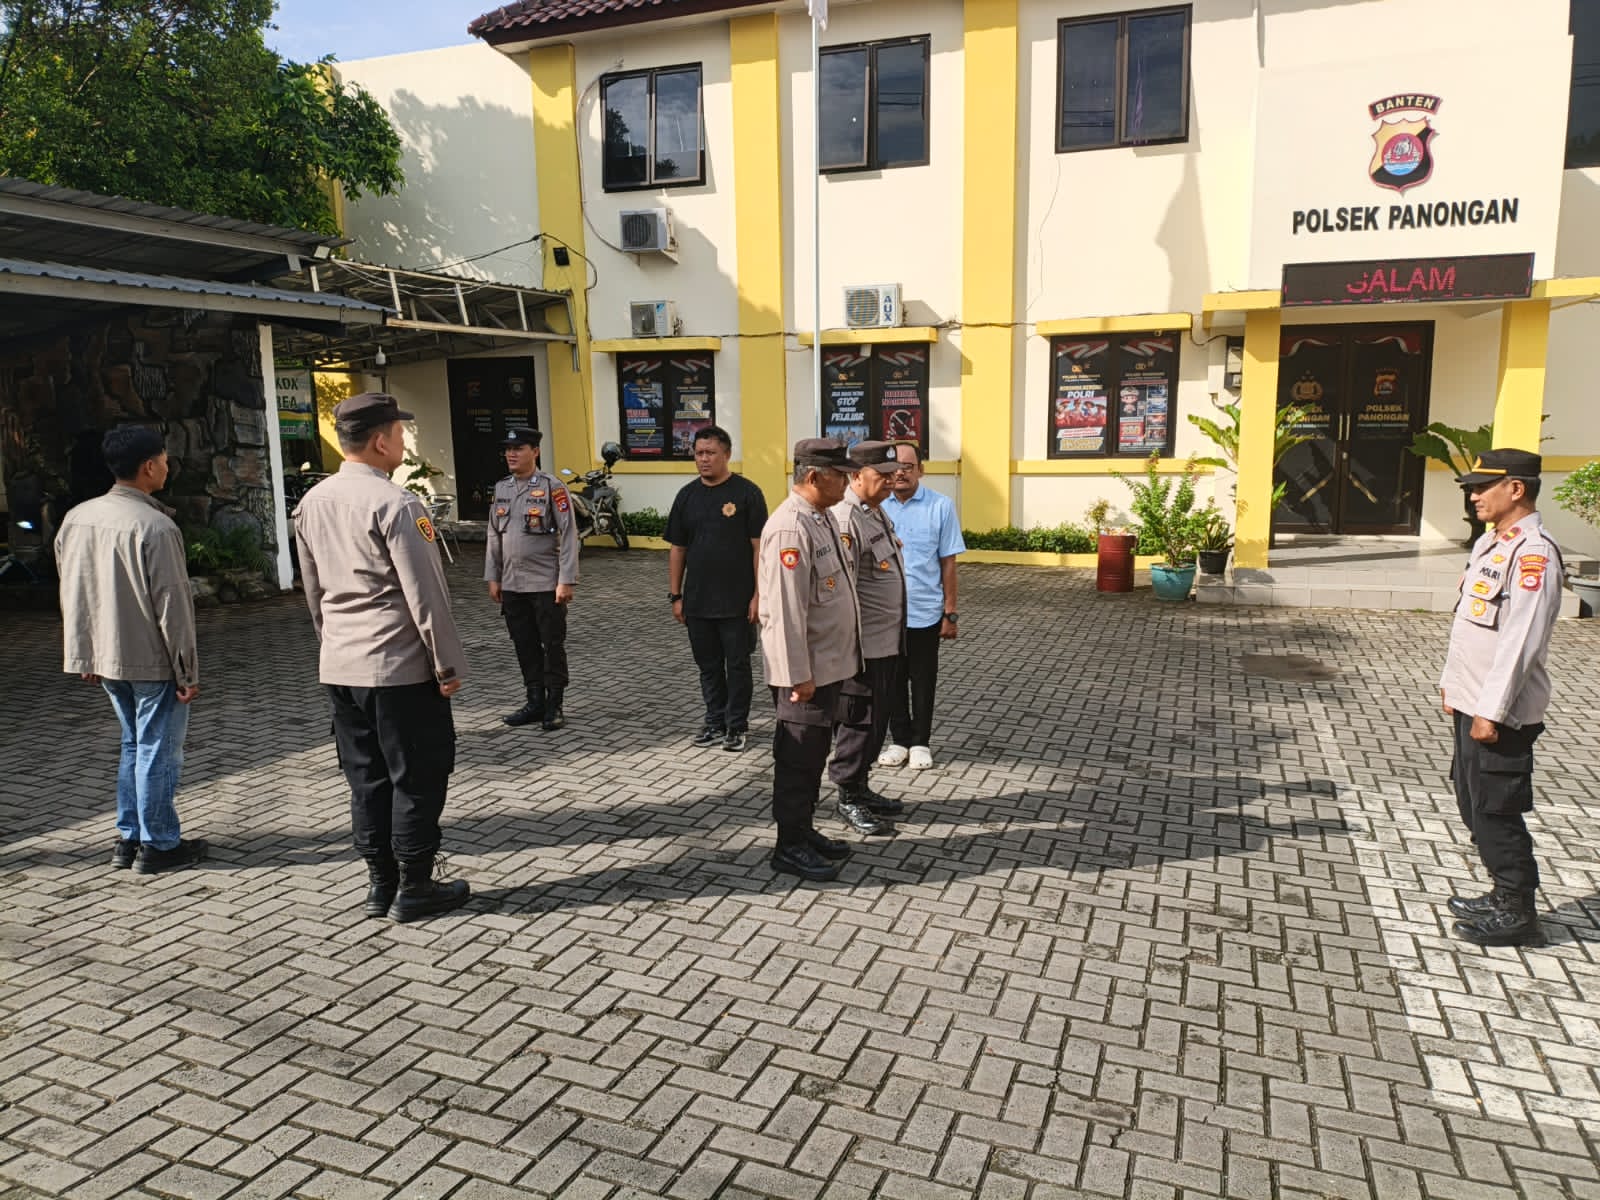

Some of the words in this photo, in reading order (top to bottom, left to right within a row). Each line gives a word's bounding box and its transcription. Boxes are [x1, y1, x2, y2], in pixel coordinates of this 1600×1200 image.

[1375, 95, 1434, 113] BANTEN
[1292, 206, 1380, 234] POLSEK
[1388, 198, 1519, 230] PANONGAN
[883, 295, 893, 321] AUX
[1067, 390, 1095, 398] POLRI
[837, 397, 859, 406] STOP
[1357, 414, 1410, 422] PANONGAN
